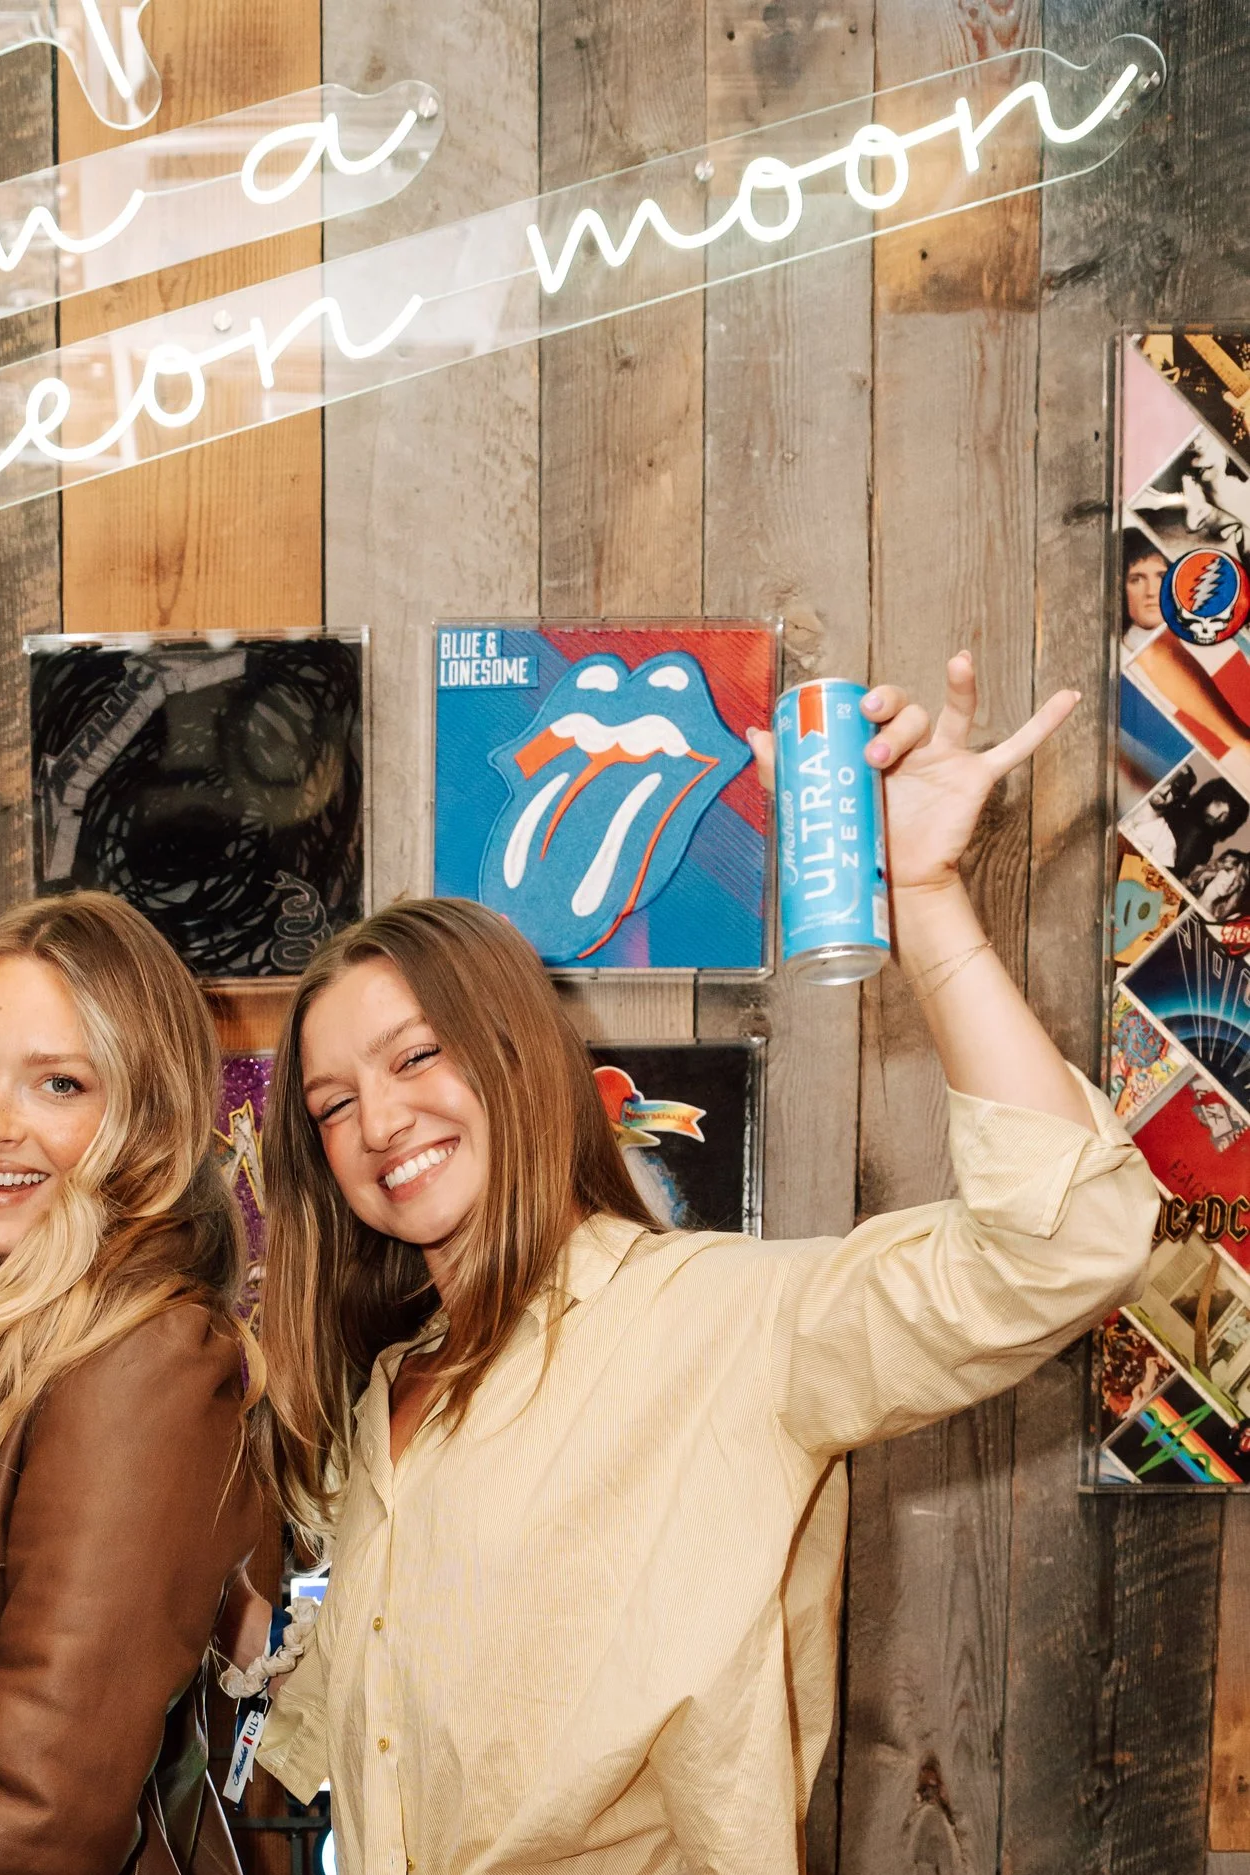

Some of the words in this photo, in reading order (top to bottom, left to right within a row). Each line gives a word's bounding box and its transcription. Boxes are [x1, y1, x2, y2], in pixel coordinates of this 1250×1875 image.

[240, 108, 420, 205] a
[526, 63, 1139, 295] moon
[439, 657, 529, 687] LONESOME
[440, 631, 483, 660] BLUE
[485, 631, 497, 659] &
[798, 747, 837, 902] ULTRA
[837, 766, 860, 869] ZERO
